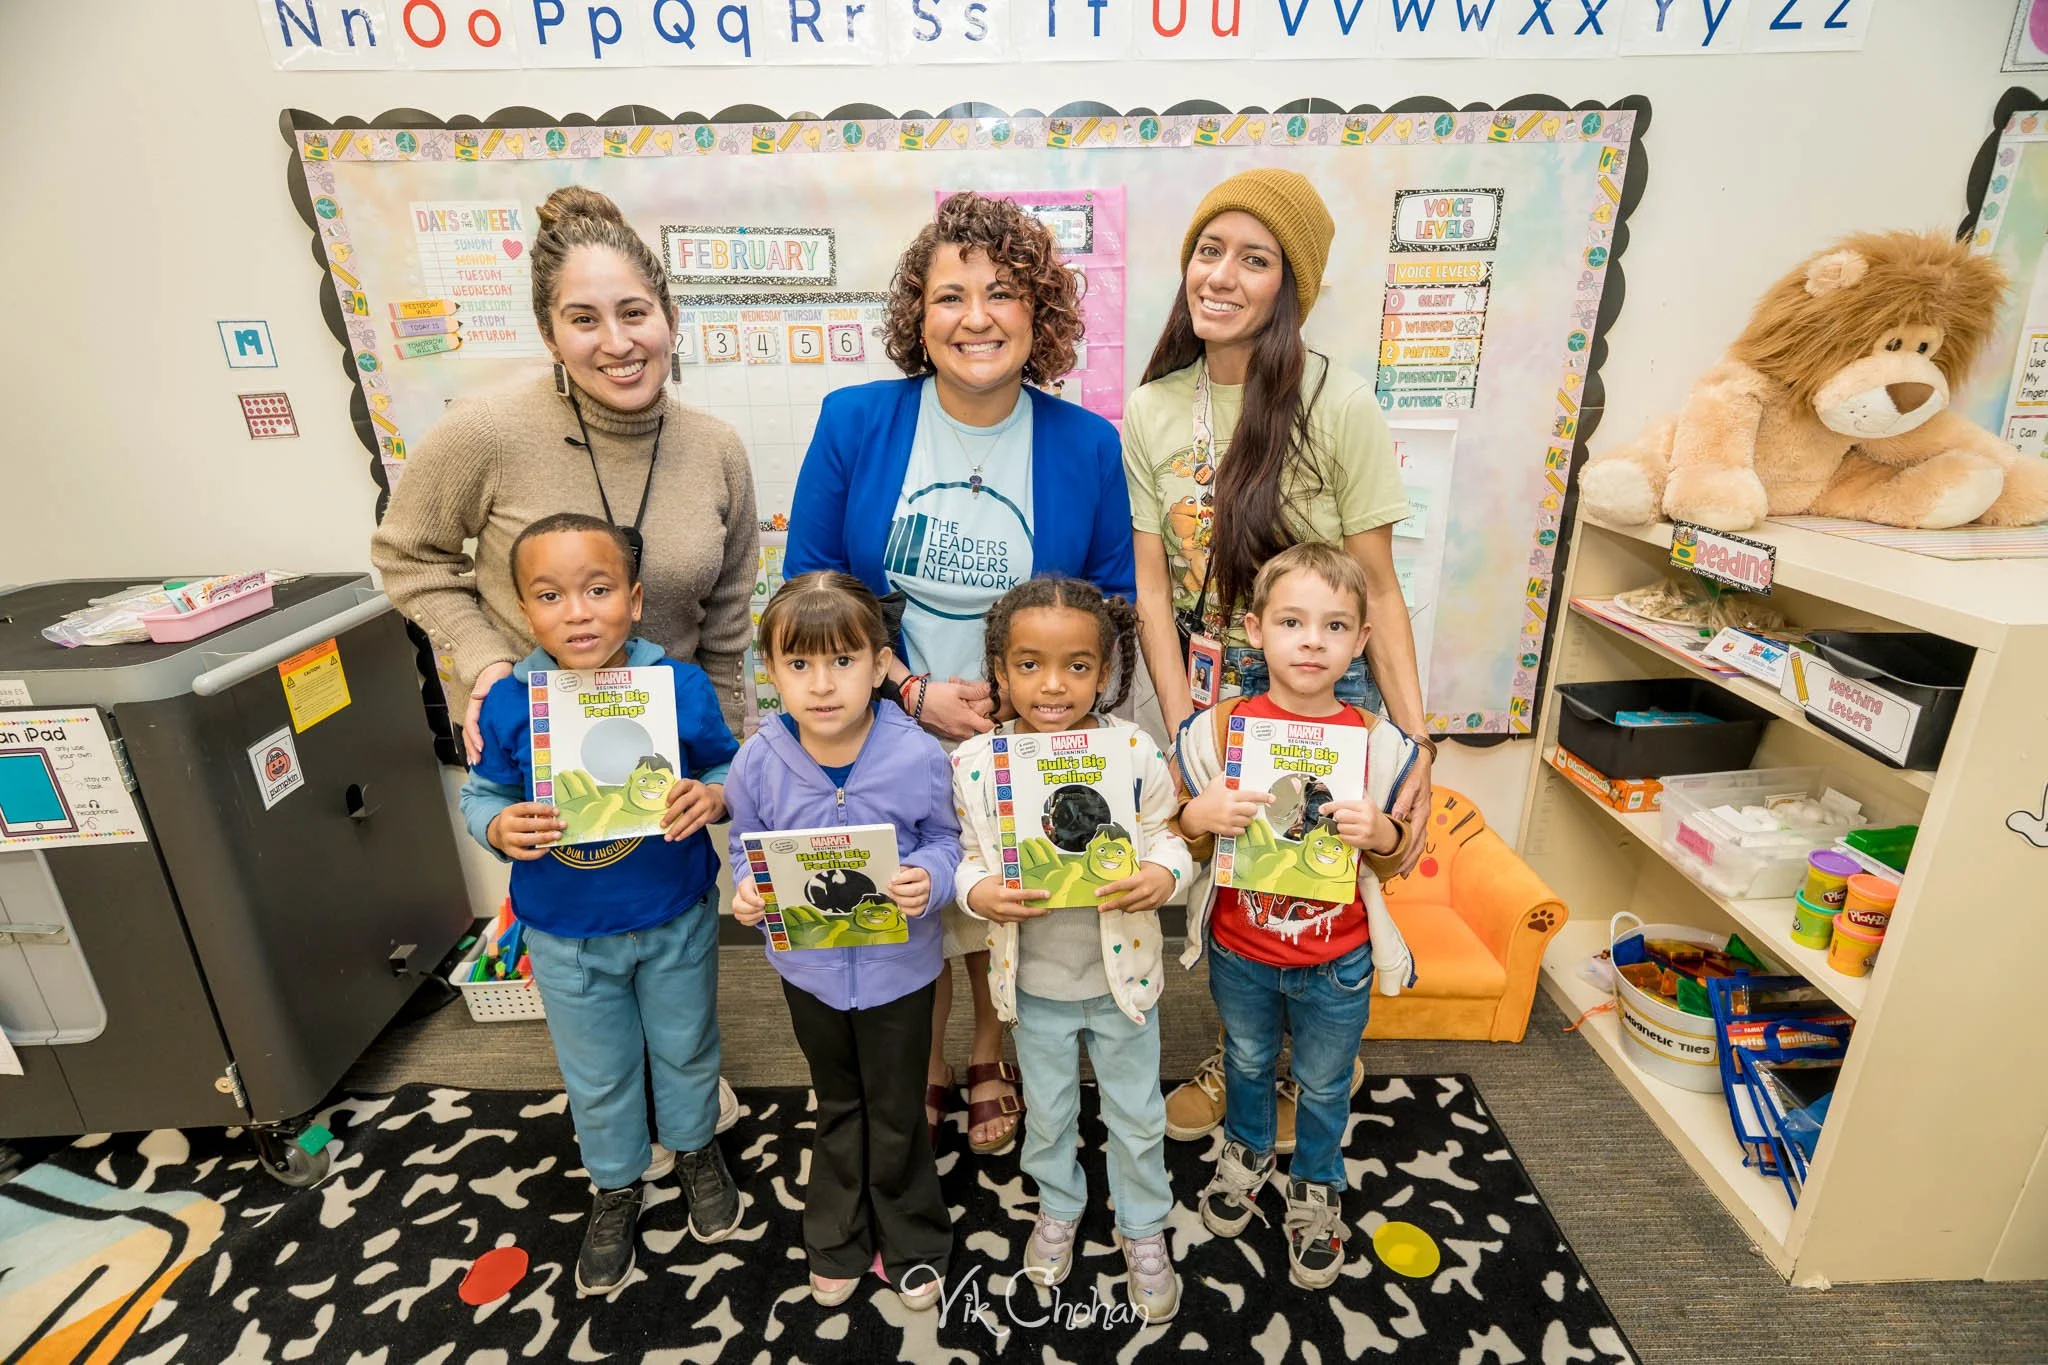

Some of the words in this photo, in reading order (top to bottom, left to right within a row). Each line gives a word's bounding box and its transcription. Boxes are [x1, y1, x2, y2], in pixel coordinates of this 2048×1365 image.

[1424, 198, 1473, 217] VOICE
[416, 210, 460, 232] DAYS
[472, 209, 522, 231] WEEK
[1416, 220, 1475, 239] LEVELS
[455, 239, 493, 250] SUNDAY
[456, 254, 497, 265] MONDAY
[678, 239, 818, 271] FEBRUARY
[457, 270, 503, 281] TUESDAY
[1399, 266, 1432, 278] VOICE
[1436, 265, 1477, 277] LEVELS
[452, 285, 513, 296] WEDNESDAY
[1418, 294, 1455, 307] SILENT
[472, 315, 505, 327] FRIDAY
[700, 310, 738, 322] TUESDAY
[741, 310, 780, 321] WEDNESDAY
[783, 309, 822, 321] THURSDAY
[828, 308, 859, 320] FRIDAY
[1405, 320, 1454, 333] WHISPER
[234, 329, 263, 356] 19
[466, 330, 517, 341] SATURDAY
[676, 334, 685, 354] 2
[716, 333, 727, 353] 3
[758, 334, 768, 355] 4
[801, 333, 811, 354] 5
[841, 333, 852, 353] 6
[1386, 346, 1393, 359] 2
[1403, 346, 1450, 359] PARTNER
[2029, 359, 2046, 368] Use
[1384, 371, 1391, 383] 3
[2025, 372, 2040, 385] My
[1380, 396, 1388, 407] 4
[2019, 428, 2037, 438] Can
[930, 517, 959, 534] THE
[929, 531, 1007, 556] LEADERS
[925, 548, 1008, 573] READERS
[1695, 540, 1772, 586] Reading
[922, 565, 1020, 590] NETWORK
[595, 671, 632, 685] MARVEL
[579, 691, 622, 704] Hulk's
[625, 689, 649, 704] Big
[757, 698, 779, 709] 160
[1828, 678, 1884, 715] Matching
[585, 704, 645, 718] Feelings
[1828, 698, 1873, 731] Letters
[24, 727, 67, 742] iPad
[1289, 724, 1324, 740] MARVEL
[1052, 734, 1088, 750] MARVEL
[1270, 744, 1312, 759] Hulk's
[1315, 747, 1338, 764] Big
[1037, 756, 1079, 771] Hulk's
[1082, 754, 1106, 770] Big
[1274, 758, 1332, 776] Feelings
[1044, 770, 1102, 785] Feelings
[269, 772, 299, 799] pumpkin
[811, 835, 850, 848] MARVEL
[566, 846, 585, 860] DUAL
[796, 851, 841, 862] Hulk's
[844, 849, 870, 859] Big
[804, 860, 866, 871] Feelings
[1625, 1012, 1673, 1047] Magnetic
[1679, 1043, 1710, 1054] Tiles
